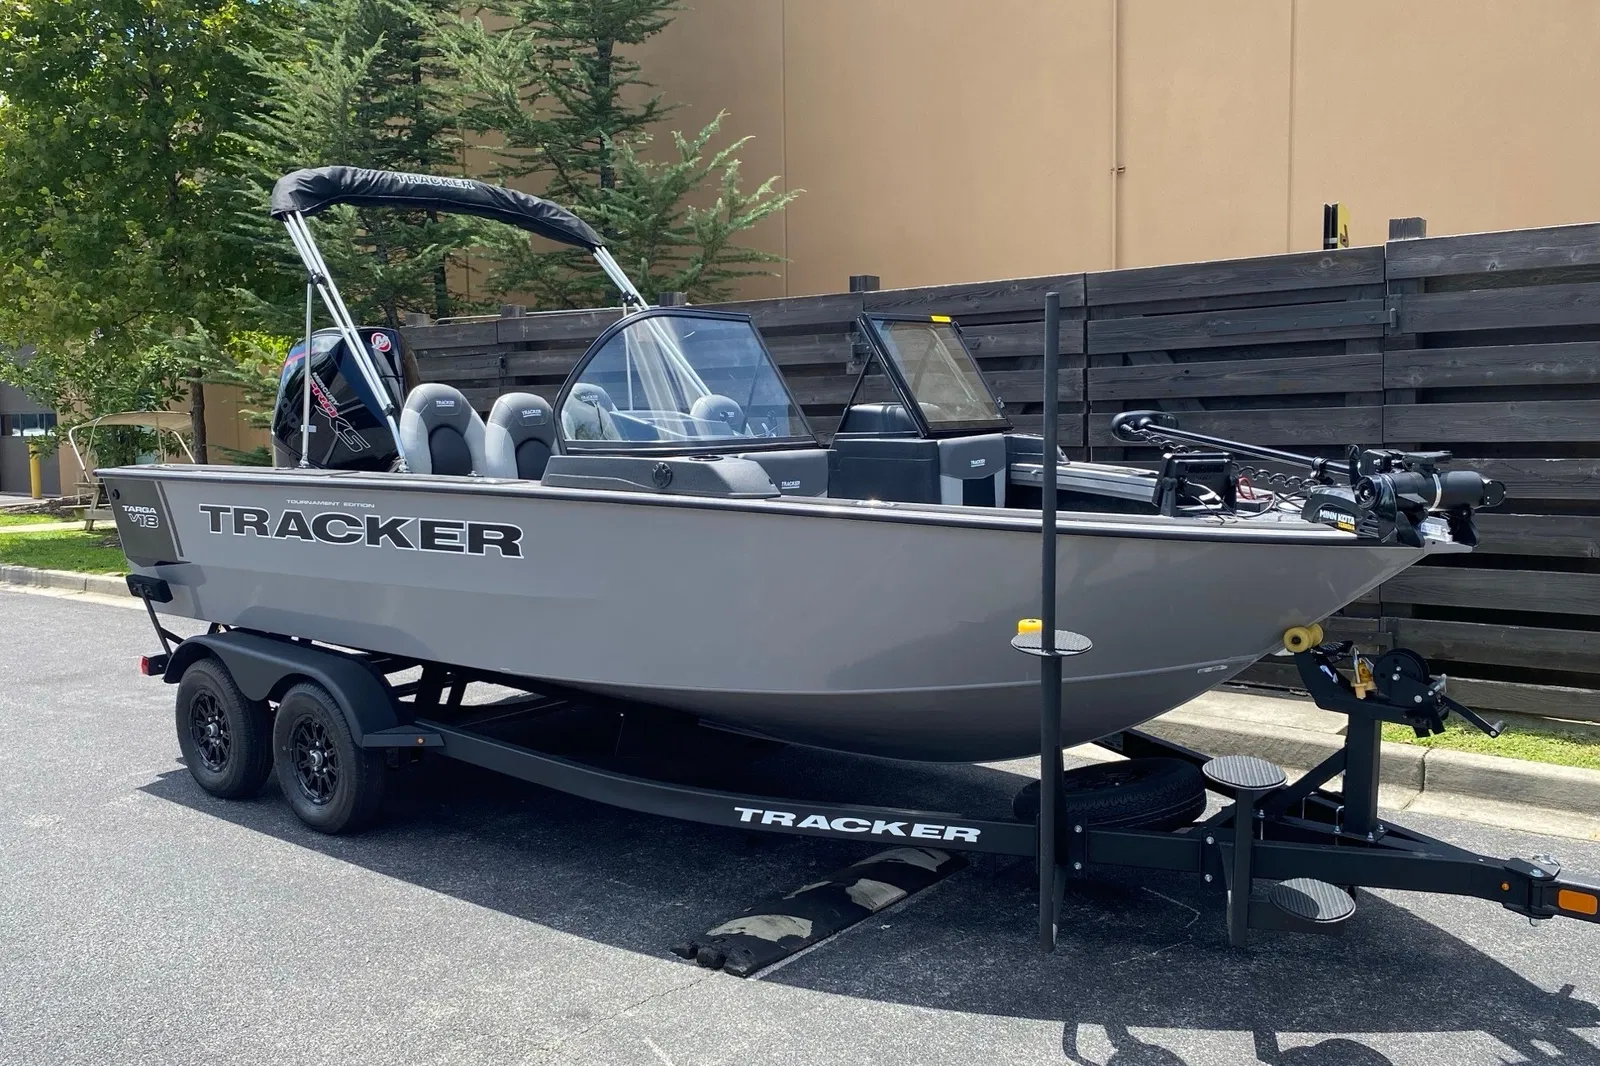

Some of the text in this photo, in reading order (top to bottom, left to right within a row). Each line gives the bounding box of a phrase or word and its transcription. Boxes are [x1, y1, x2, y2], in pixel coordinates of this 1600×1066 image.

[394, 174, 475, 189] TRACKER
[312, 371, 340, 406] MERCURY
[522, 409, 542, 418] TRACKER
[314, 404, 371, 453] XS
[121, 504, 157, 514] TARGA
[1319, 509, 1356, 525] MINN KOTA
[128, 513, 159, 529] V18
[199, 503, 524, 559] TRACKER
[734, 806, 982, 843] TRACKER
